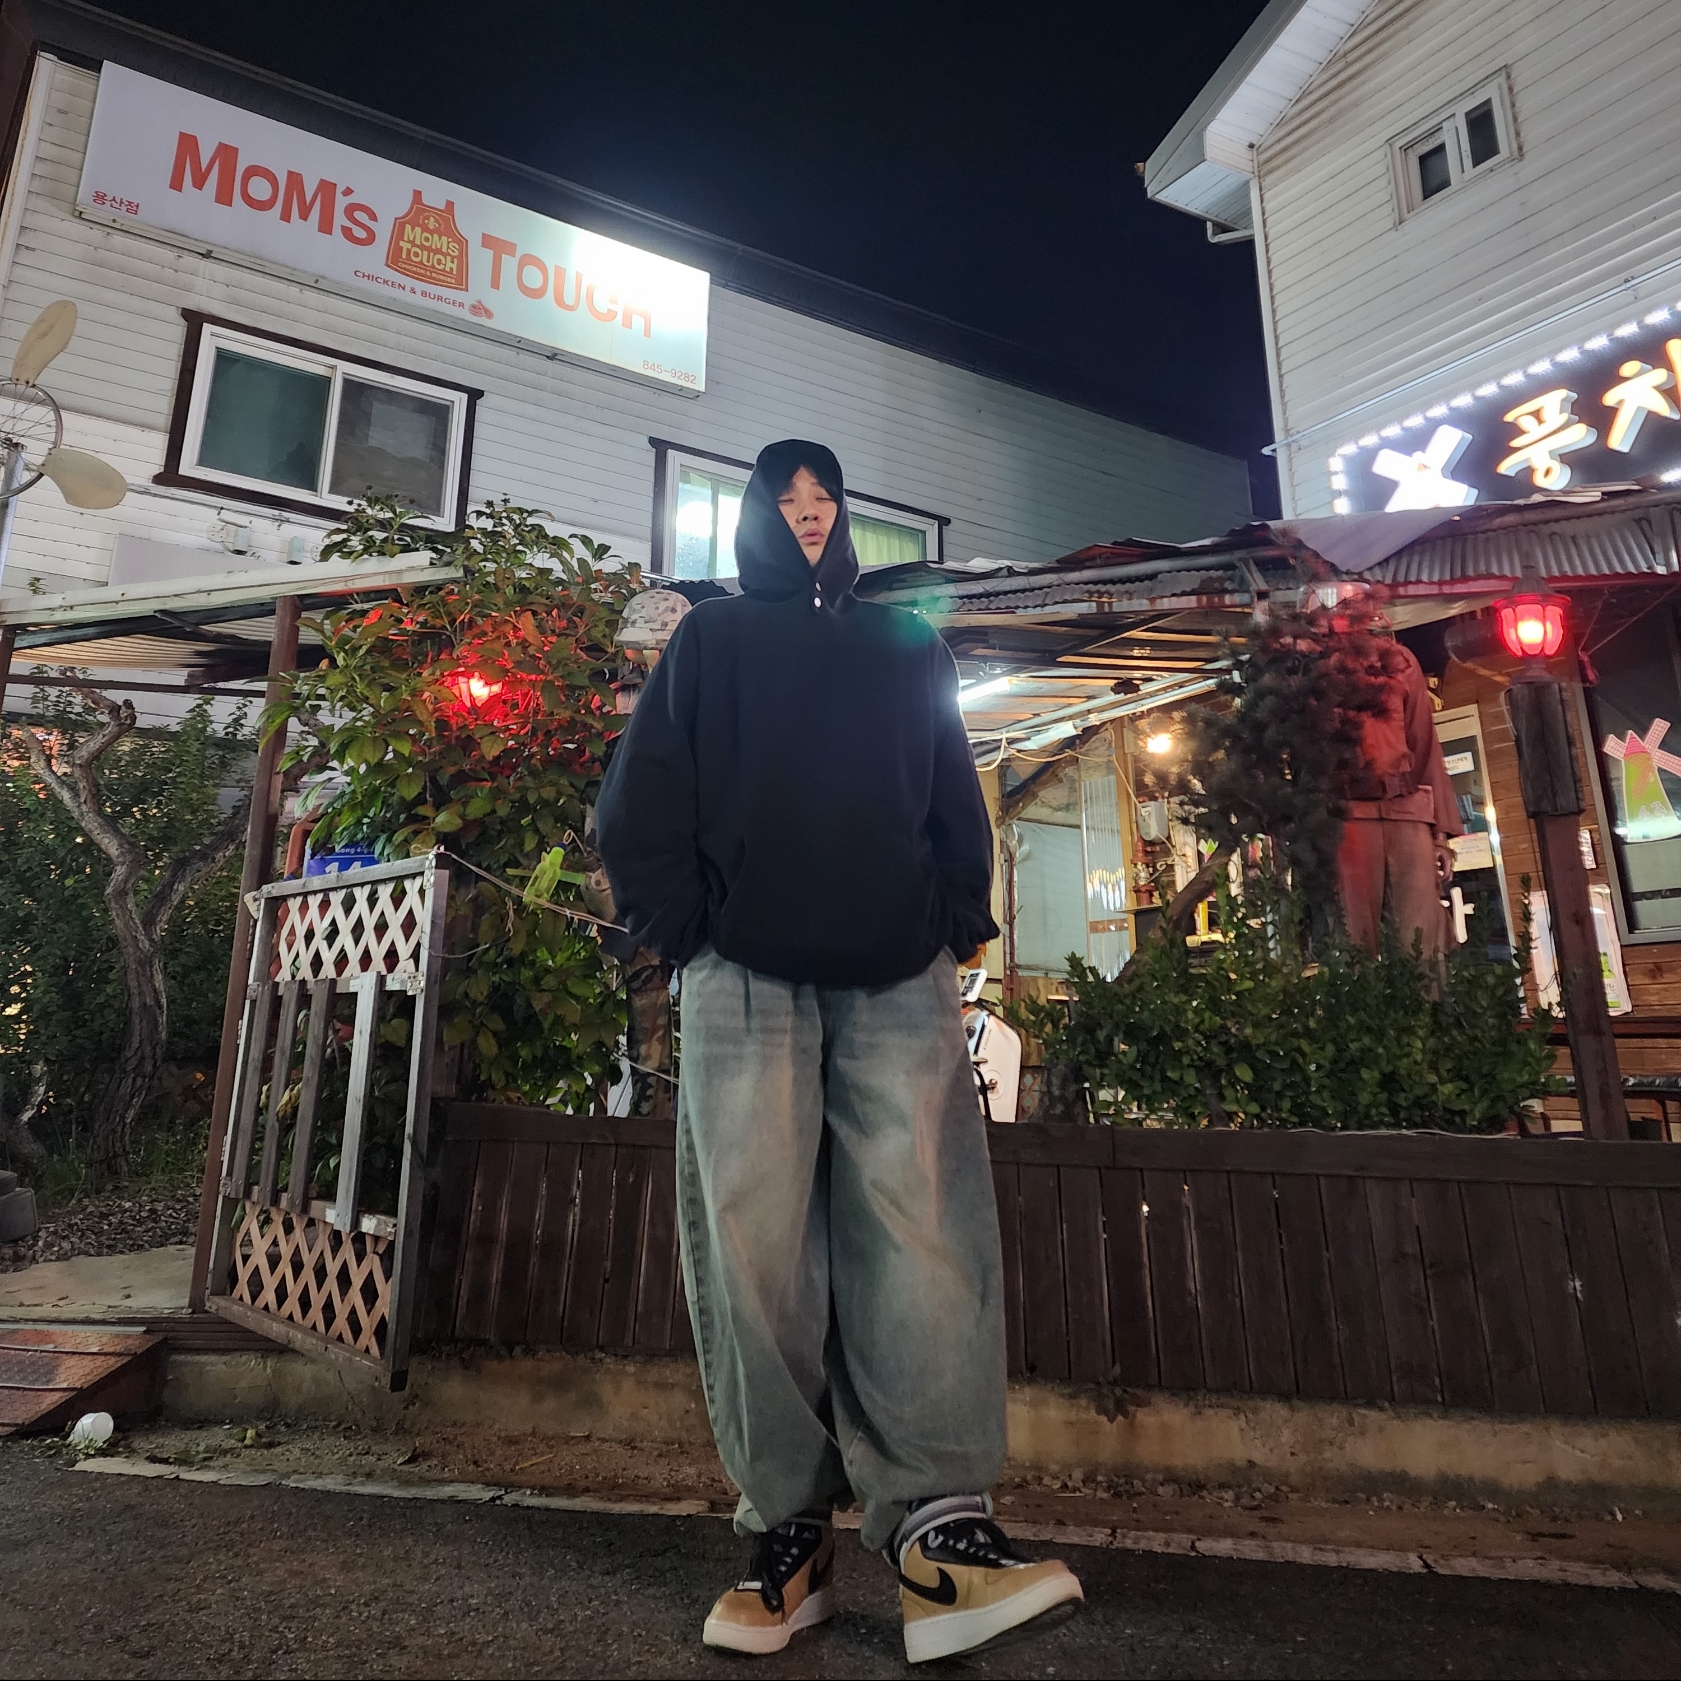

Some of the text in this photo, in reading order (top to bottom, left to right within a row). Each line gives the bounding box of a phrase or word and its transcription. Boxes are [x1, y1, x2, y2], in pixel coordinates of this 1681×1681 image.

[92, 190, 140, 216] 용산점
[399, 241, 458, 275] TOUCH
[353, 269, 466, 310] CHICKEN & BURGER
[642, 360, 698, 385] 845-9282
